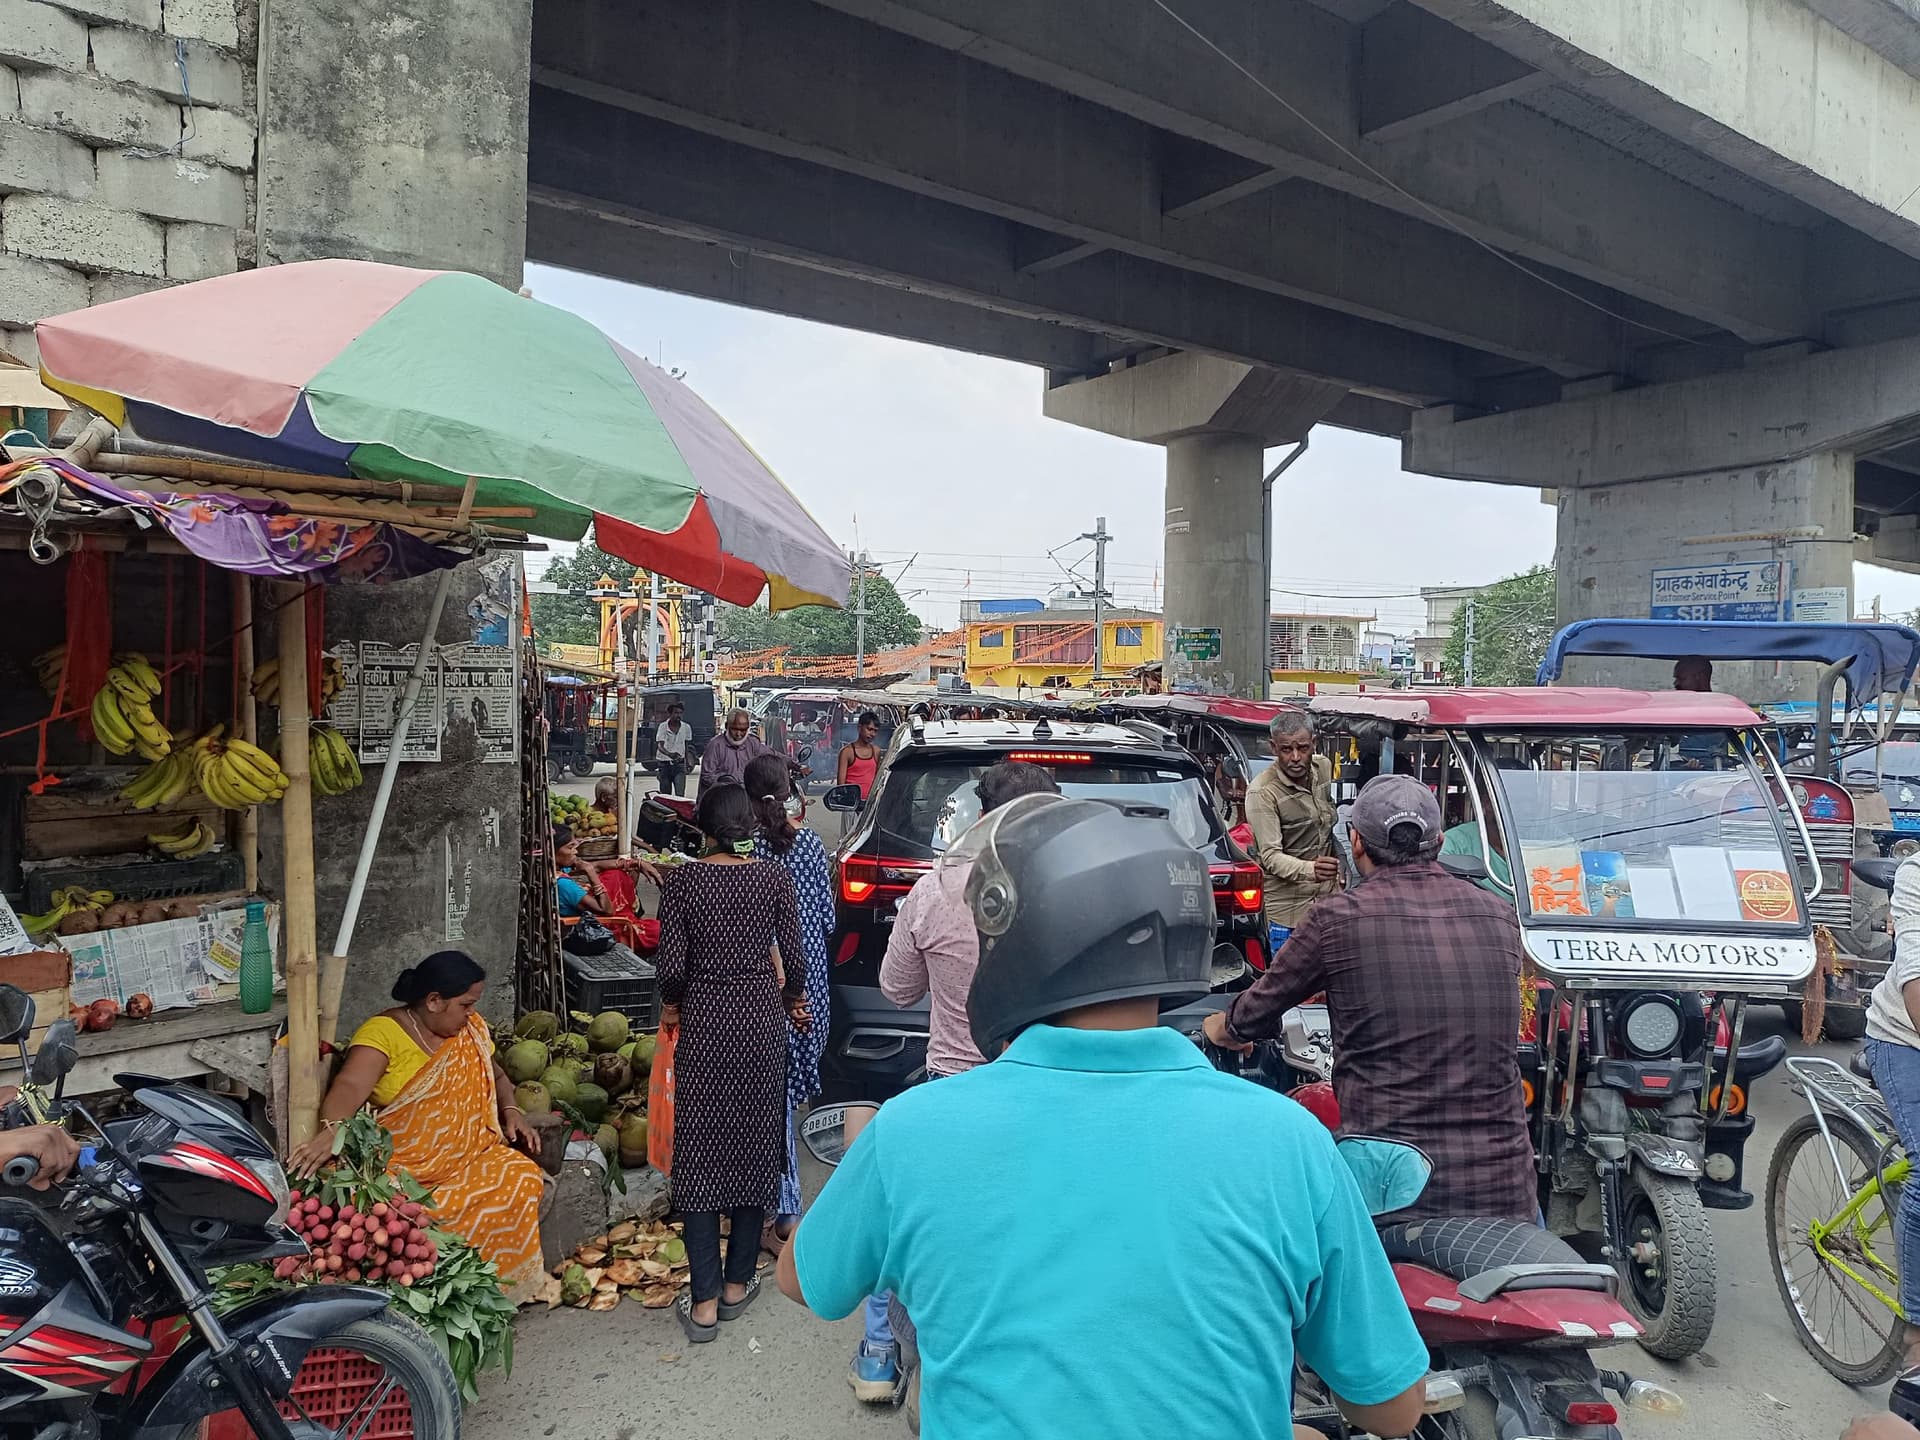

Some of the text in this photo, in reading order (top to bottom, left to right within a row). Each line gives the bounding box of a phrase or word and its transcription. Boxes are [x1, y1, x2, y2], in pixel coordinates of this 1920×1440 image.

[1656, 576, 1693, 593] ग्राहक
[1695, 571, 1719, 590] सेवा
[1756, 584, 1787, 593] ZER
[1691, 591, 1717, 602] Service
[1718, 589, 1740, 600] Point
[1677, 605, 1713, 620] SBI
[444, 668, 469, 686] हकीम
[488, 668, 512, 686] नासिर
[1547, 939, 1780, 967] TERRA MOTORS
[266, 1339, 292, 1379] Combi Brake
